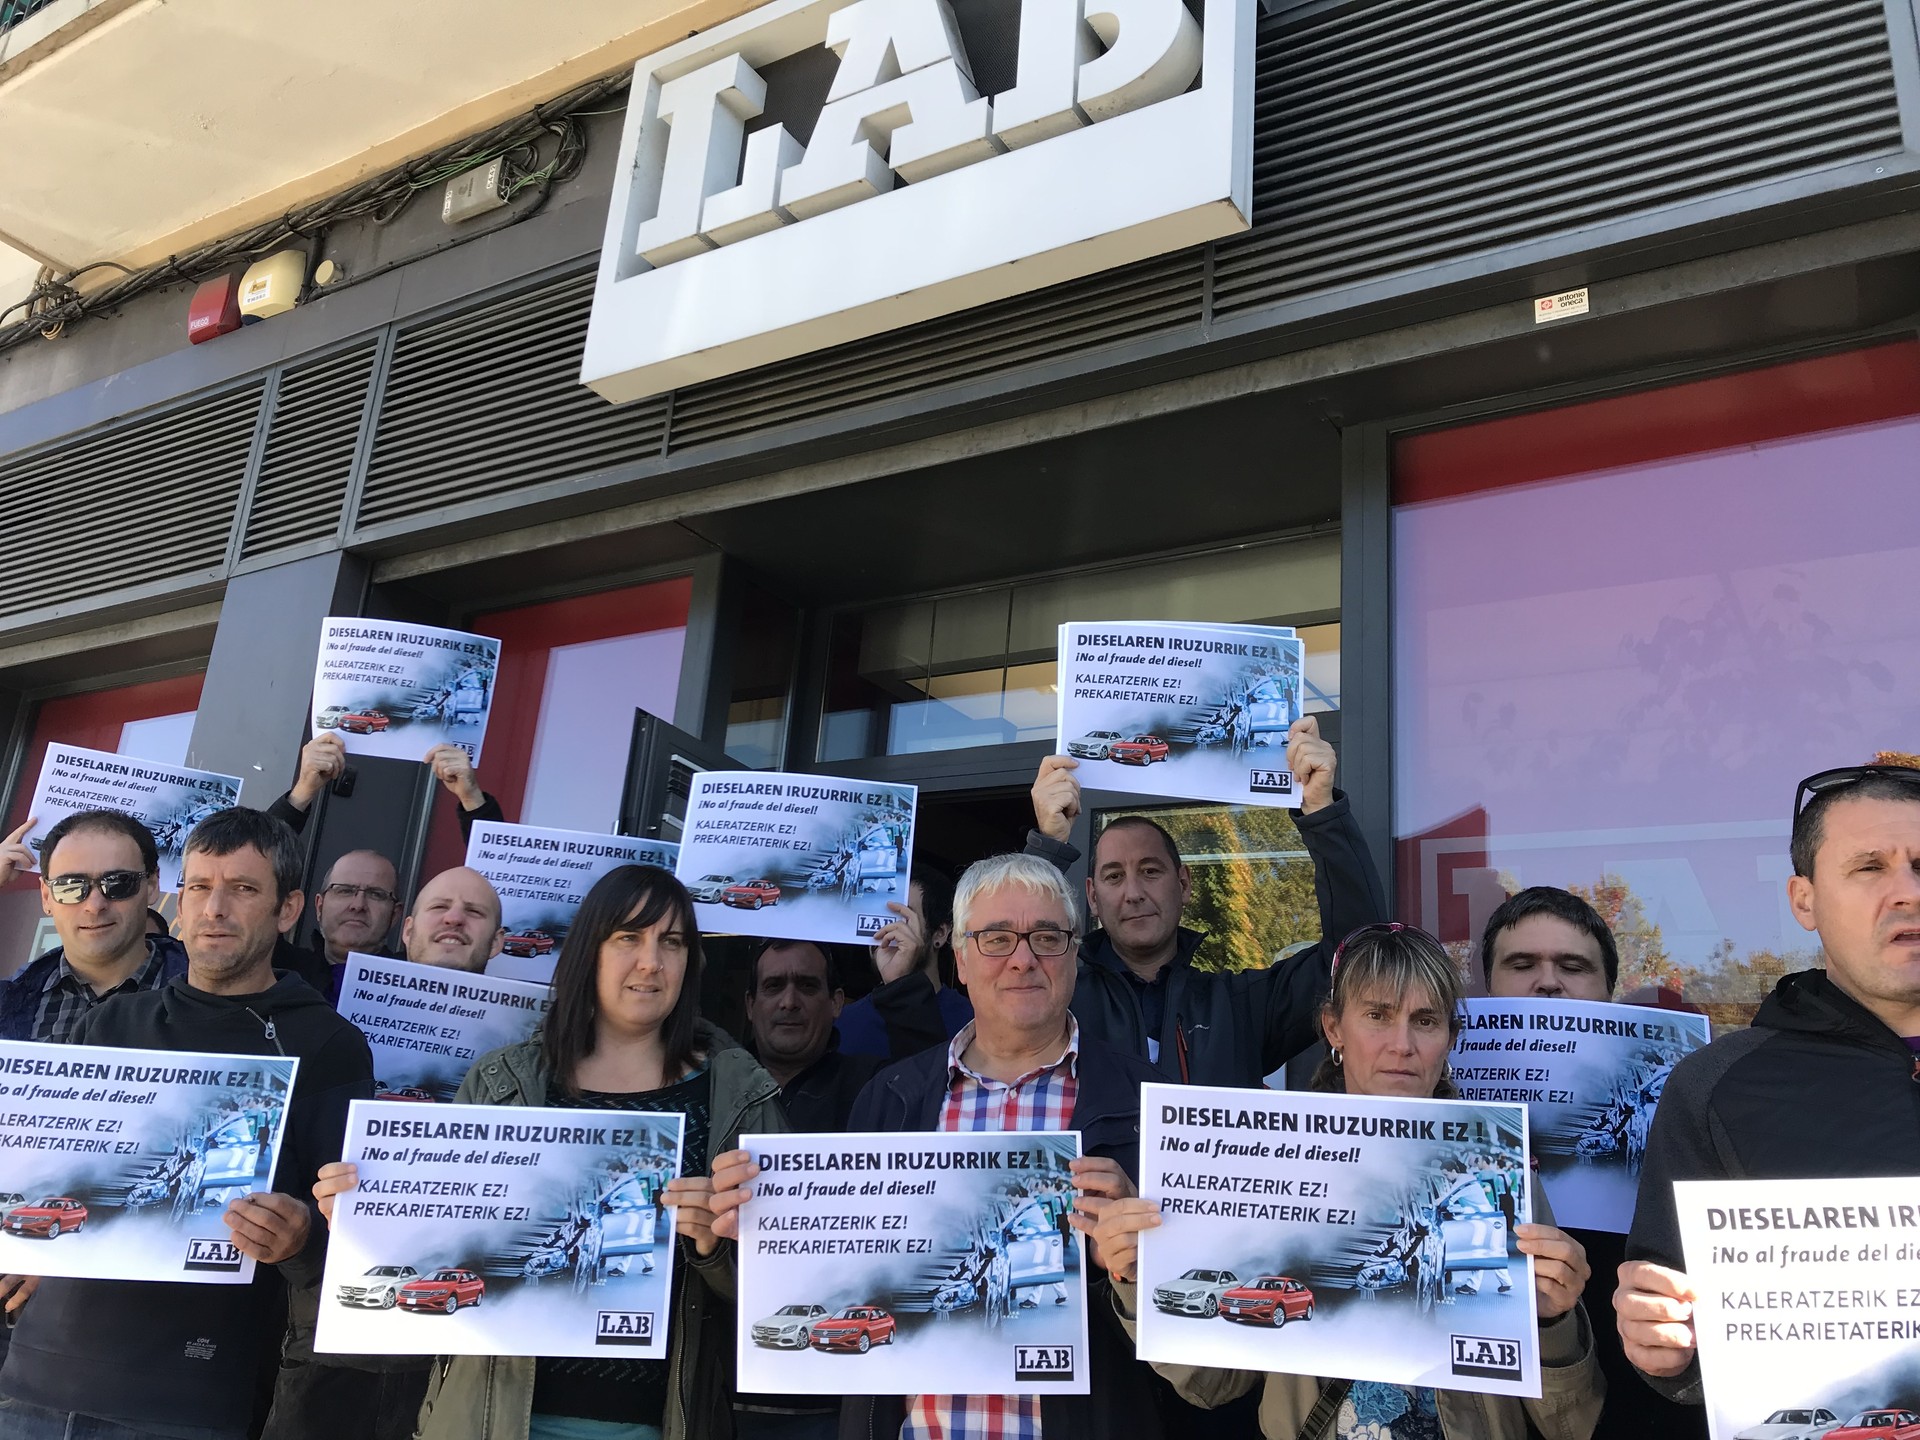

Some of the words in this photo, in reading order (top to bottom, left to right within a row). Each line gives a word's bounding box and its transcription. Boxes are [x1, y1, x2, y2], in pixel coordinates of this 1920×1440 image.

[1558, 291, 1585, 302] antonio
[1560, 298, 1583, 307] oneca
[190, 315, 209, 329] FUEGO
[329, 627, 393, 642] DIESELAREN
[396, 633, 461, 652] IRUZURRIK
[463, 644, 475, 654] EZ
[340, 643, 348, 652] al
[347, 644, 376, 654] fraude
[378, 647, 392, 655] del
[393, 648, 424, 658] diesel!
[1077, 634, 1165, 649] DIESELAREN
[1168, 638, 1249, 657] IRUZURRIK
[1251, 645, 1268, 658] EZ
[324, 660, 385, 672] KALERATZERIK
[388, 666, 405, 674] EZ!
[1075, 652, 1095, 662] ¡No
[1097, 653, 1108, 662] al
[1108, 653, 1146, 665] fraude
[1149, 656, 1165, 665] del
[1167, 657, 1202, 668] diesel!
[322, 672, 398, 686] PREKARIETATERIK
[400, 679, 417, 689] EZ!
[1075, 674, 1159, 687] KALERATZERIK
[1162, 679, 1181, 688] EZ!
[1074, 689, 1175, 704] PREKARIETATERIK
[1179, 695, 1198, 706] EZ!
[56, 754, 130, 776] DIESELAREN
[132, 768, 197, 788] IRUZURRIK
[1253, 772, 1291, 787] LAB
[70, 772, 80, 781] al
[79, 773, 110, 786] fraude
[112, 778, 126, 788] del
[128, 781, 158, 794] diesel!
[48, 785, 119, 804] KALERATZERIK
[120, 798, 137, 807] EZ!
[701, 783, 783, 797] DIESELAREN
[786, 785, 863, 805] IRUZURRIK
[866, 794, 882, 806] EZ
[698, 800, 717, 810] ¡No
[718, 801, 728, 809] al
[728, 801, 763, 811] fraude
[766, 803, 782, 812] del
[784, 805, 818, 815] diesel!
[695, 820, 775, 833] KALERATZERIK
[778, 825, 797, 835] EZ!
[481, 833, 560, 852] DIESELAREN
[563, 842, 636, 860] IRUZURRIK
[639, 851, 654, 863] EZ
[693, 834, 790, 849] PREKARIETATERIK
[793, 842, 811, 851] EZ!
[477, 851, 496, 861] ¡No
[498, 853, 507, 861] al
[507, 853, 541, 865] fraude
[543, 857, 558, 867] del
[560, 859, 593, 870] diesel!
[553, 878, 572, 889] EZ!
[358, 968, 449, 996] DIESELAREN
[452, 985, 537, 1011] IRUZURRIK
[353, 989, 374, 1001] ¡No
[376, 993, 388, 1003] al
[387, 994, 427, 1010] fraude
[429, 1001, 447, 1013] del
[449, 1005, 486, 1020] diesel!
[350, 1013, 439, 1037] KALERATZERIK
[441, 1028, 461, 1040] EZ!
[1529, 1014, 1638, 1038] IRUZURRIK
[1643, 1024, 1665, 1041] EZ
[455, 1047, 475, 1060] EZ!
[1457, 1038, 1502, 1054] fraude
[1505, 1039, 1526, 1052] del
[1529, 1041, 1577, 1054] diesel!
[114, 1065, 221, 1087] IRUZURRIK
[225, 1071, 250, 1088] EZ
[1525, 1068, 1550, 1082] EZ!
[12, 1084, 29, 1096] al
[26, 1084, 79, 1101] fraude
[82, 1089, 105, 1102] del
[108, 1090, 157, 1105] diesel!
[1548, 1090, 1574, 1104] EZ!
[0, 1113, 93, 1131] LERATZERIK
[95, 1119, 123, 1133] EZ!
[366, 1119, 490, 1141] DIESELAREN
[495, 1124, 607, 1145] IRUZURRIK
[611, 1129, 634, 1146] EZ
[1161, 1105, 1299, 1133] DIESELAREN
[1305, 1113, 1436, 1140] IRUZURRIK
[1442, 1122, 1469, 1142] EZ
[114, 1141, 140, 1155] EZ!
[360, 1147, 390, 1162] ¡No
[393, 1148, 409, 1162] al
[408, 1148, 461, 1166] fraude
[464, 1149, 488, 1165] del
[491, 1151, 541, 1167] diesel!
[1160, 1137, 1190, 1154] ¡No
[1194, 1137, 1212, 1155] al
[1212, 1139, 1271, 1159] fraude
[1274, 1142, 1301, 1160] del
[1304, 1145, 1361, 1163] diesel!
[759, 1152, 881, 1172] DIESELAREN
[887, 1151, 1002, 1171] IRUZURRIK
[1007, 1151, 1031, 1169] EZ
[357, 1179, 477, 1197] KALERATZERIK
[482, 1183, 509, 1198] EZ!
[756, 1182, 784, 1197] ¡No
[788, 1180, 803, 1196] al
[804, 1180, 856, 1200] fraude
[860, 1180, 884, 1196] del
[887, 1180, 936, 1196] diesel!
[1161, 1172, 1293, 1196] KALERATZERIK
[1299, 1182, 1328, 1198] EZ!
[353, 1202, 500, 1221] PREKARIETATERIK
[503, 1206, 531, 1221] EZ!
[1160, 1198, 1321, 1224] PREKARIETATERIK
[1326, 1209, 1357, 1226] EZ!
[1706, 1205, 1880, 1231] DIESELAREN
[758, 1215, 876, 1231] KALERATZERIK
[881, 1215, 908, 1230] EZ!
[189, 1242, 242, 1262] LAB
[757, 1239, 901, 1255] PREKARIETATERIK
[906, 1239, 932, 1254] EZ!
[1712, 1246, 1749, 1264] ¡No
[1756, 1245, 1774, 1263] al
[1780, 1244, 1850, 1269] fraude
[1858, 1244, 1888, 1262] del
[1721, 1290, 1888, 1310] KALERATZERIK
[1896, 1289, 1920, 1307] EZ
[600, 1314, 651, 1335] LAB
[1018, 1350, 1070, 1370] LAB
[1454, 1339, 1519, 1367] LAB
